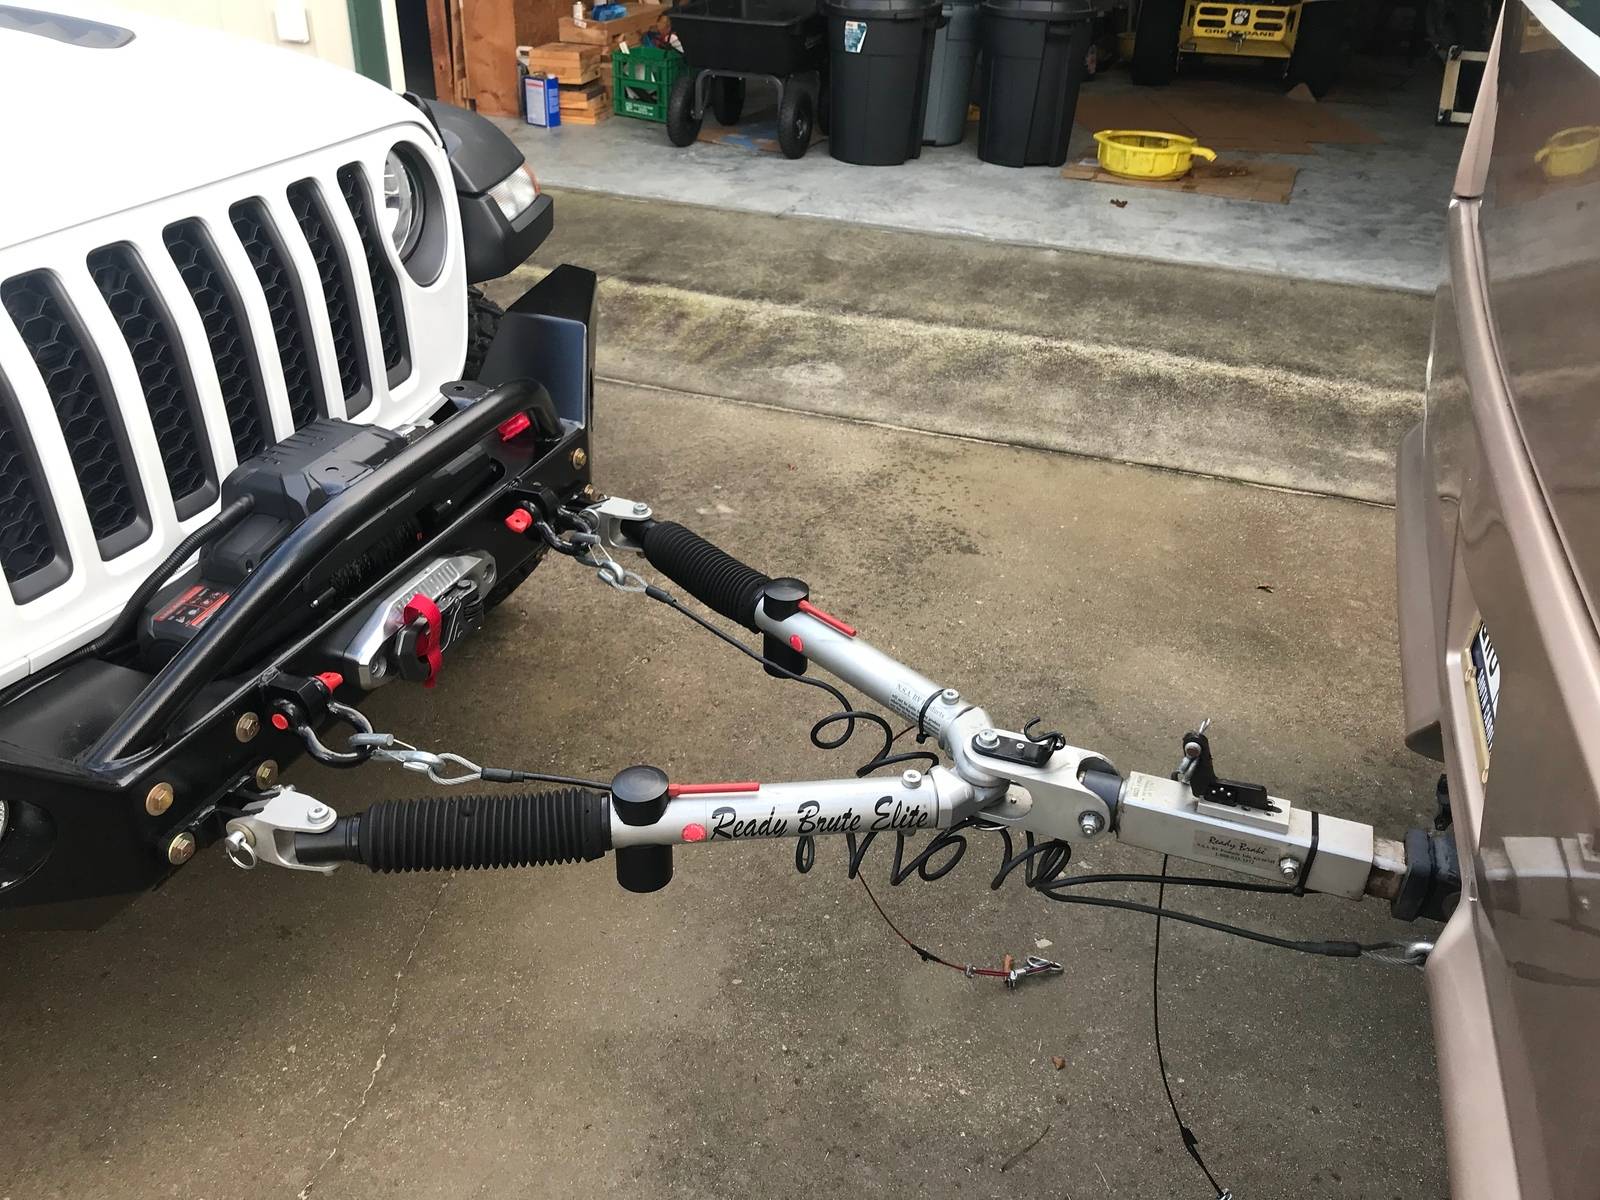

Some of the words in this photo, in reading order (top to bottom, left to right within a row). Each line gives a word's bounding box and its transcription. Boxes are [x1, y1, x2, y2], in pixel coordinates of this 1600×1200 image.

[711, 806, 788, 840] Ready
[797, 800, 861, 833] Brute
[870, 795, 928, 831] Elite
[1209, 836, 1236, 850] Ready
